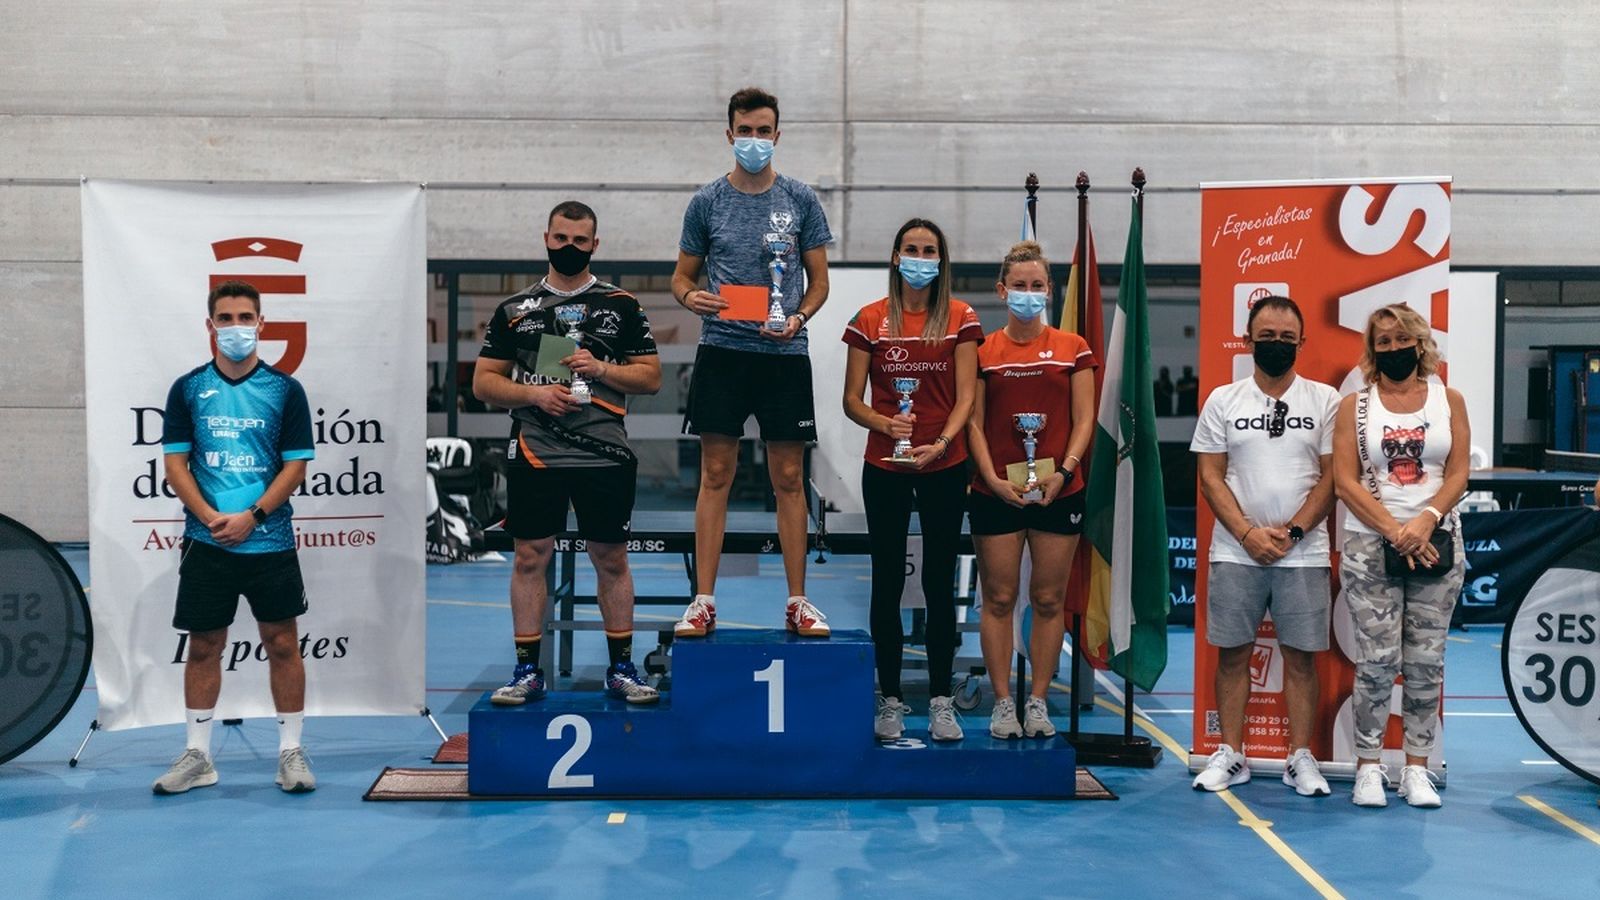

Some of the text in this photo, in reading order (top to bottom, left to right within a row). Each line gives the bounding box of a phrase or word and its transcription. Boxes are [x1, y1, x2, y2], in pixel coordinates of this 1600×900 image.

[1212, 205, 1313, 247] ¡Especialistas
[1258, 235, 1274, 246] en
[1237, 239, 1304, 274] Granada!
[881, 362, 948, 372] VIDRIOSERVICE
[1234, 414, 1315, 431] adias
[1359, 398, 1368, 419] LOLA
[170, 632, 349, 671] potes
[753, 659, 785, 733] 1
[1522, 653, 1596, 707] 30
[546, 714, 594, 788] 2
